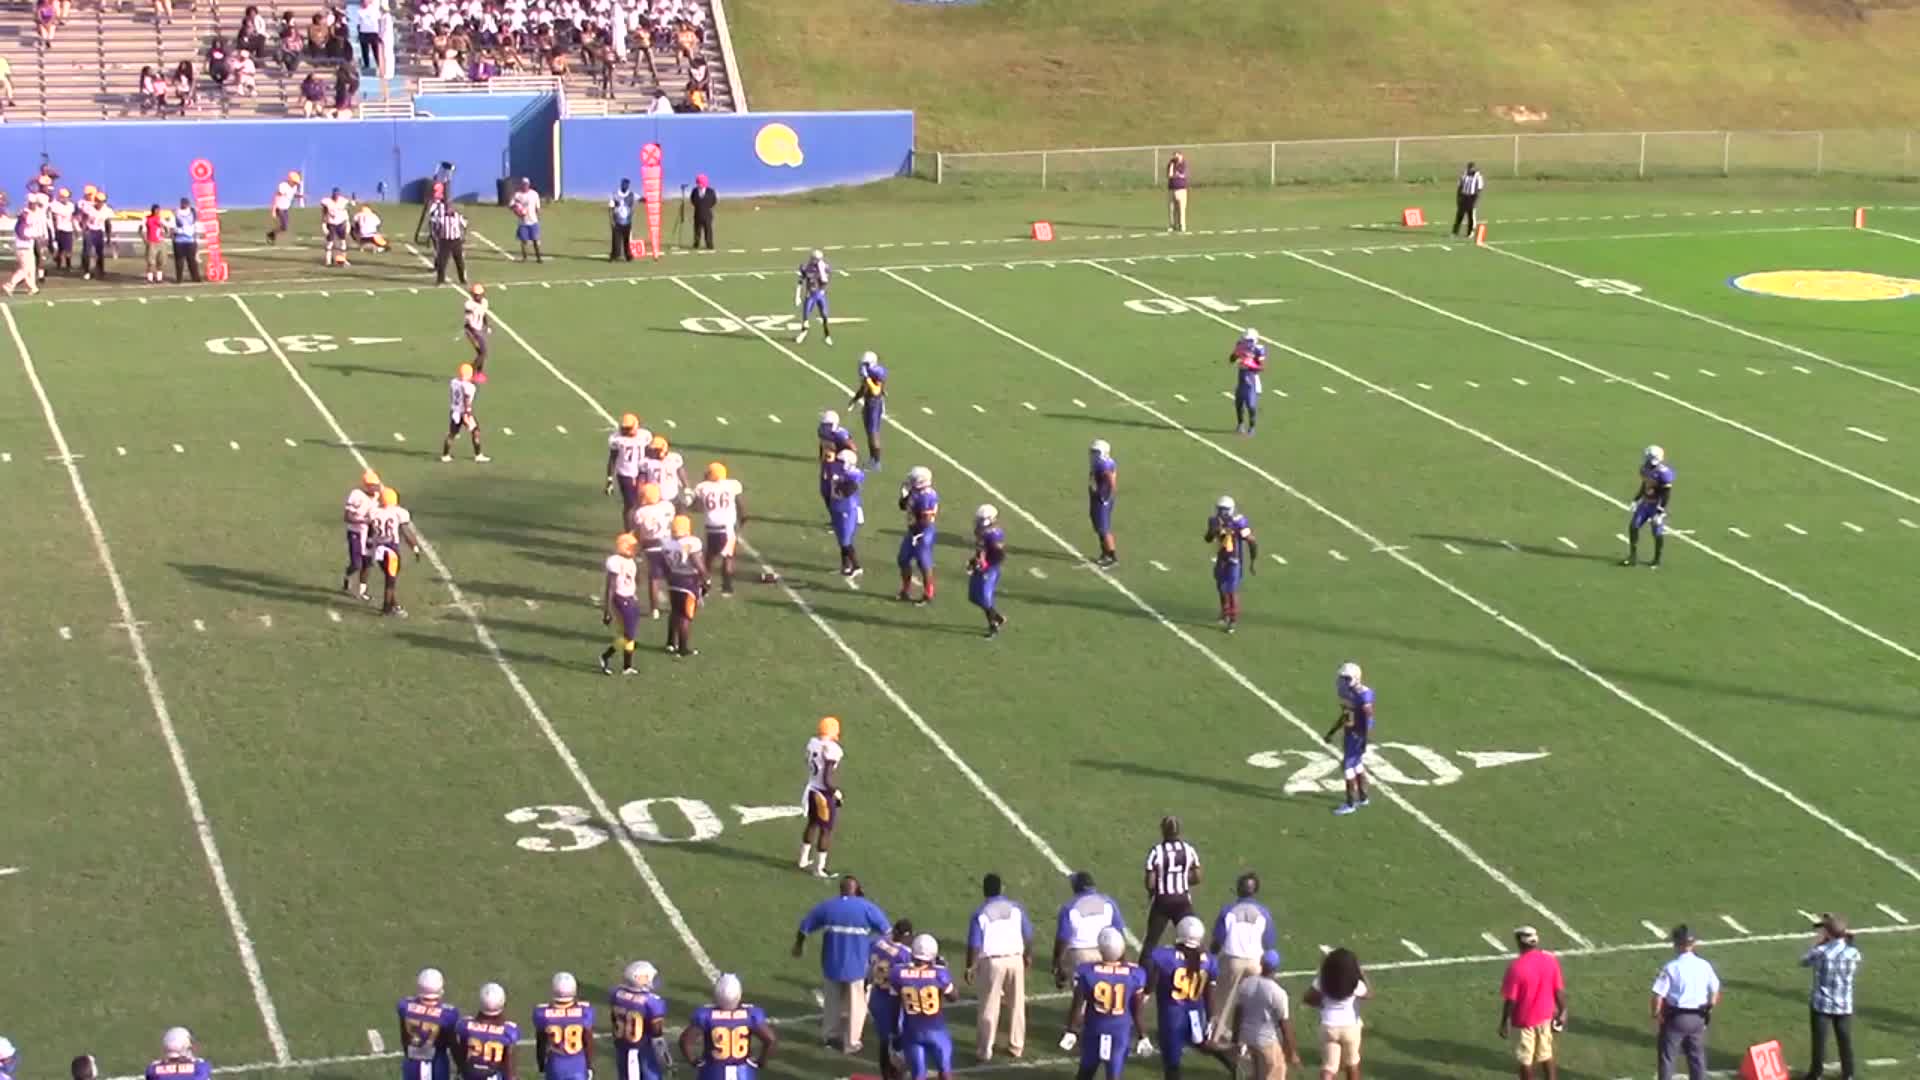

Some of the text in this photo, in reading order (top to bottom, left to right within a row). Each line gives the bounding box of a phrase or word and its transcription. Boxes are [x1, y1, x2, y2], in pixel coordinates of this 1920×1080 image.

[680, 315, 804, 333] 20
[205, 334, 338, 354] 30
[704, 492, 729, 511] 66
[1247, 743, 1463, 794] 20
[504, 797, 724, 852] 30
[1168, 851, 1183, 872] L
[1093, 981, 1124, 1015] 91
[711, 1025, 748, 1060] 96
[1756, 1049, 1786, 1080] 20
